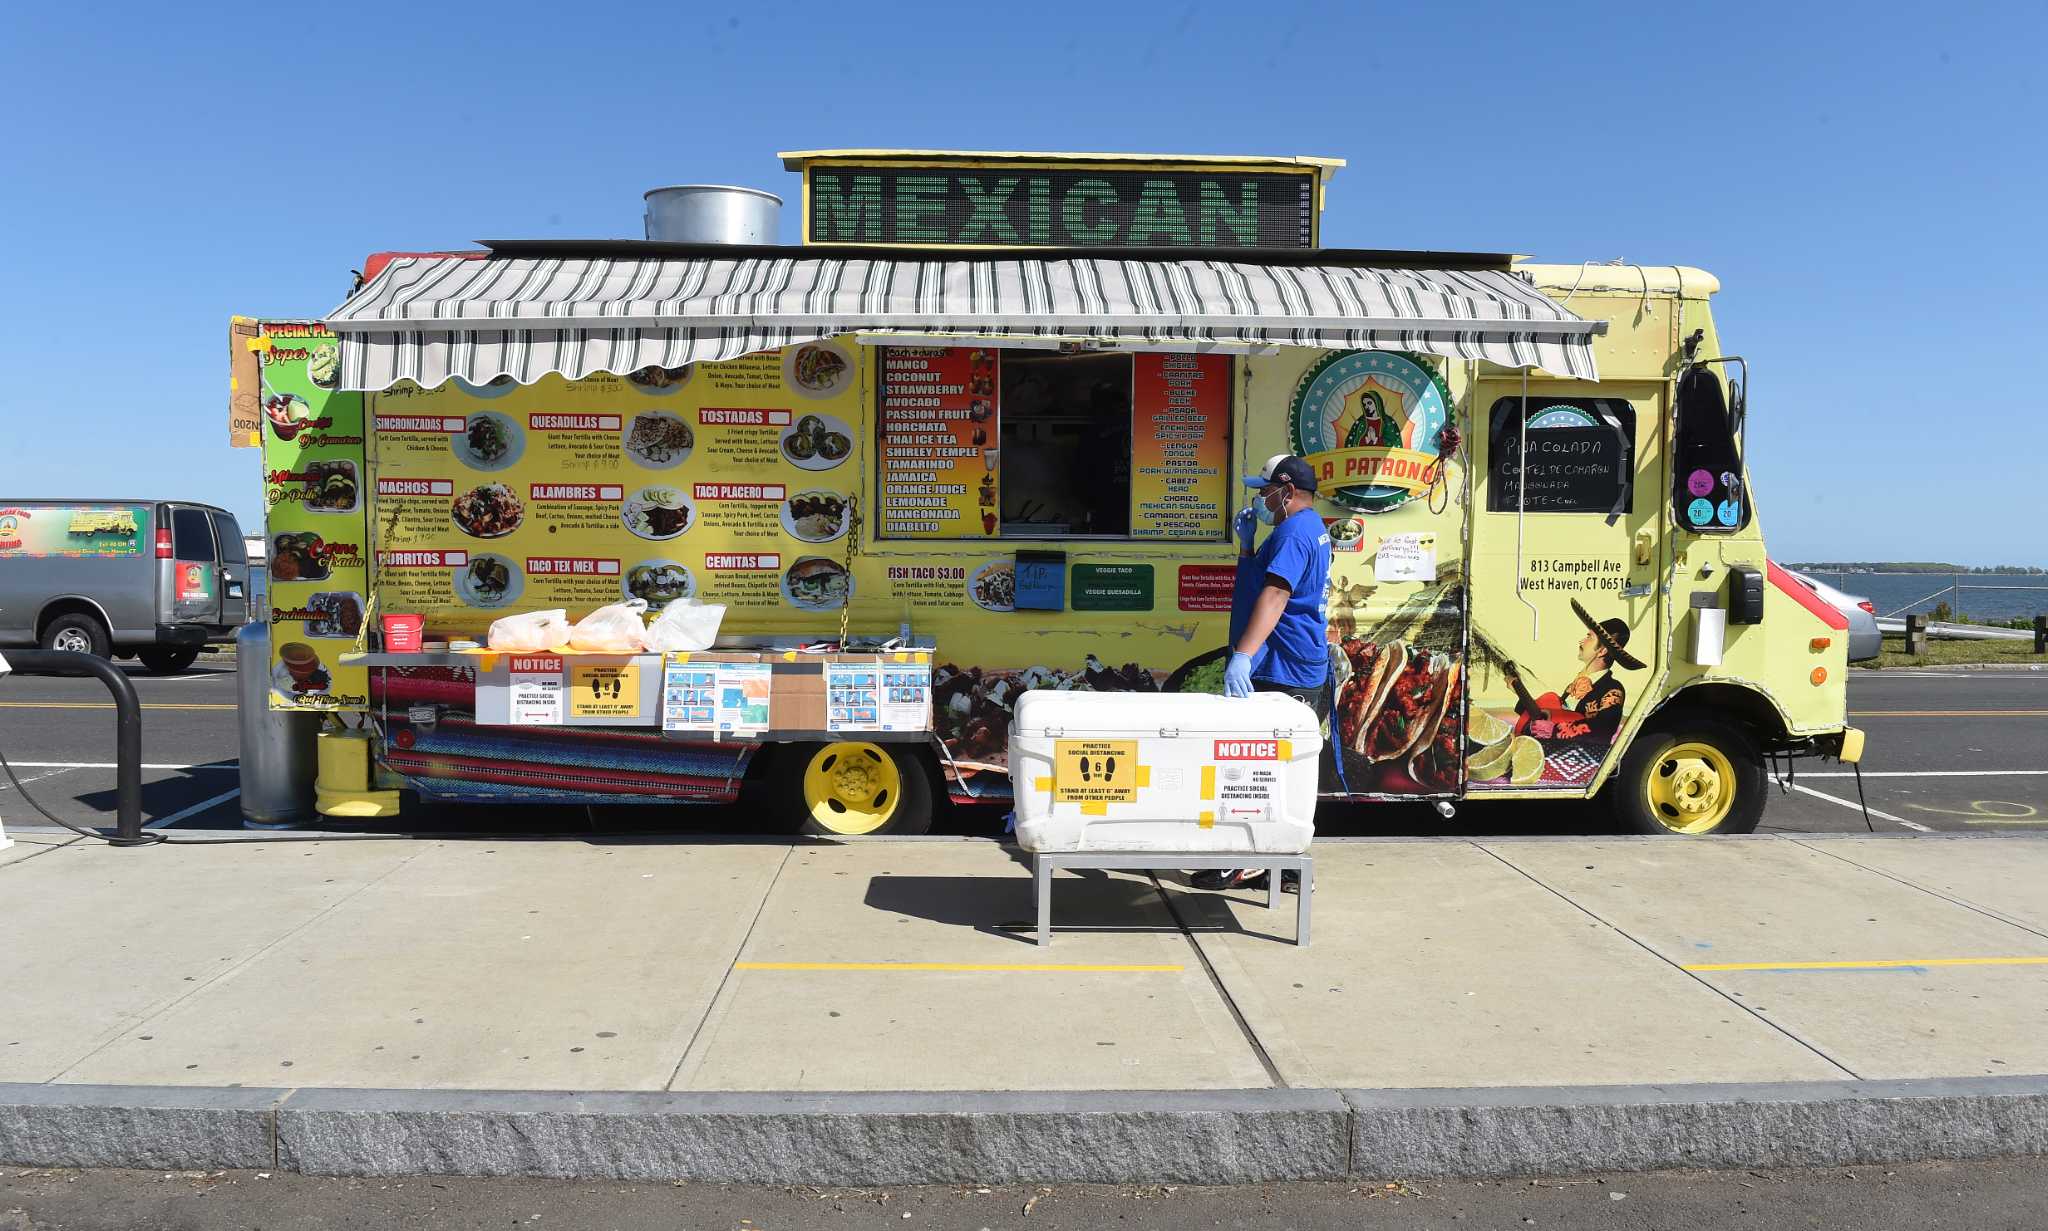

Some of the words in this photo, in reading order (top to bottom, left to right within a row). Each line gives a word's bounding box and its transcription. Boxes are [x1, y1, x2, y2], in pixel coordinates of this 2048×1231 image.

[815, 174, 1258, 246] MEXICAN
[263, 323, 309, 337] SPECIAL
[886, 360, 928, 370] MANGO
[886, 372, 942, 382] COCONUT
[383, 384, 413, 398] Shrimp
[886, 385, 964, 394] STRAWBERRY
[885, 397, 940, 407] AVOCADO
[701, 410, 763, 423] TOSTADAS
[886, 410, 936, 419] PASSION
[939, 410, 972, 419] FRUIT
[376, 418, 441, 431] SINCRONIZADAS
[531, 415, 597, 429] QUESADILLAS
[886, 422, 947, 432] HORCHATA
[886, 435, 912, 444] THAI
[915, 435, 935, 444] ICE
[937, 435, 957, 444] TEA
[886, 447, 933, 457] SHIRLEY
[936, 447, 978, 457] TEMPLE
[1542, 441, 1601, 453] COLADA
[886, 460, 954, 469] TAMARINDO
[1345, 458, 1435, 482] PATRONA
[886, 472, 937, 482] JAMAICA
[380, 481, 429, 493] NACHOS
[532, 487, 596, 499] ALAMBRES
[695, 485, 717, 498] TACO
[721, 485, 761, 498] PLACERO
[886, 485, 932, 494] ORANGE
[934, 485, 967, 494] JUICE
[886, 497, 947, 507] LEMONADE
[886, 509, 960, 519] MANGONADA
[886, 522, 939, 531] DIABLITO
[309, 536, 358, 559] Carne
[528, 560, 551, 573] TACO
[554, 560, 570, 573] TEX
[573, 560, 594, 573] MEX
[706, 556, 757, 568] CEMITAS
[1530, 560, 1549, 572] 813
[1552, 560, 1600, 576] Campbell
[1603, 560, 1621, 572] Ave
[888, 568, 909, 579] FISH
[911, 568, 935, 579] TACO
[937, 567, 965, 579] $3.00
[1520, 578, 1547, 590] West
[1548, 578, 1582, 592] Haven,
[1585, 578, 1598, 590] CT
[1600, 578, 1632, 590] 06516
[513, 658, 561, 670] NOTICE
[604, 682, 610, 691] 6
[1218, 743, 1276, 757] NOTICE
[1095, 762, 1102, 772] 6
